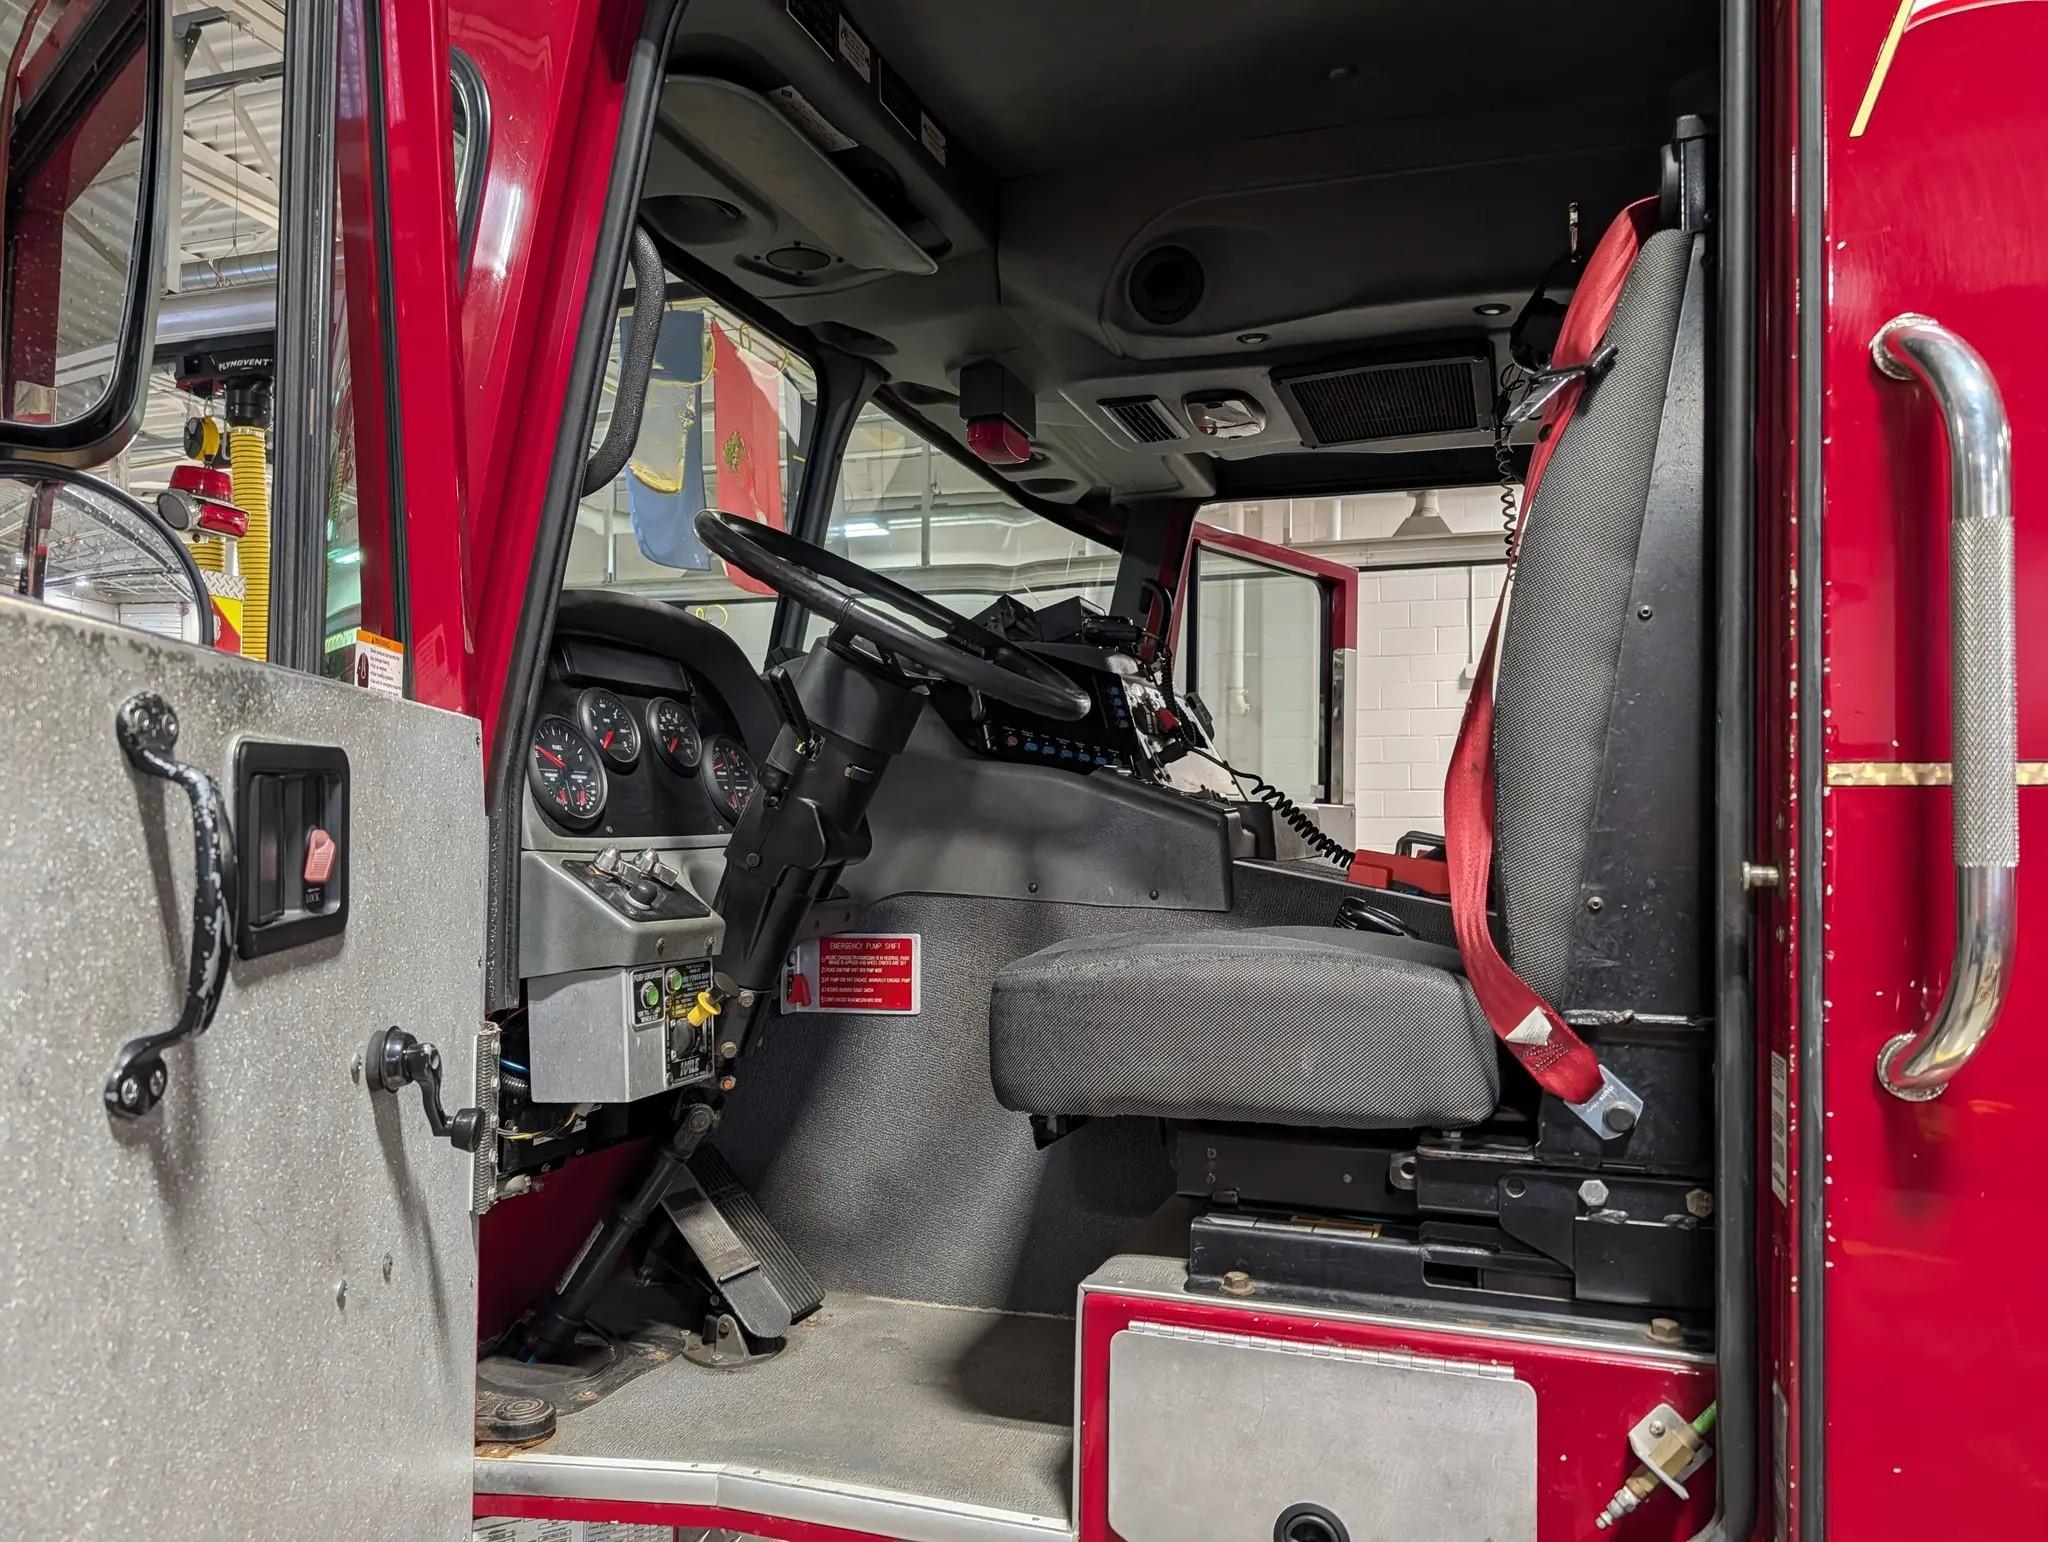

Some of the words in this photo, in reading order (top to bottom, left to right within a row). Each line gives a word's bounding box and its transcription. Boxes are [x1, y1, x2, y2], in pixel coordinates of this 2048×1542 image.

[218, 358, 270, 372] PLYMOVENT
[829, 942, 863, 950] EMERGENCY
[866, 942, 882, 950] PUMP
[884, 942, 901, 950] SHIFT
